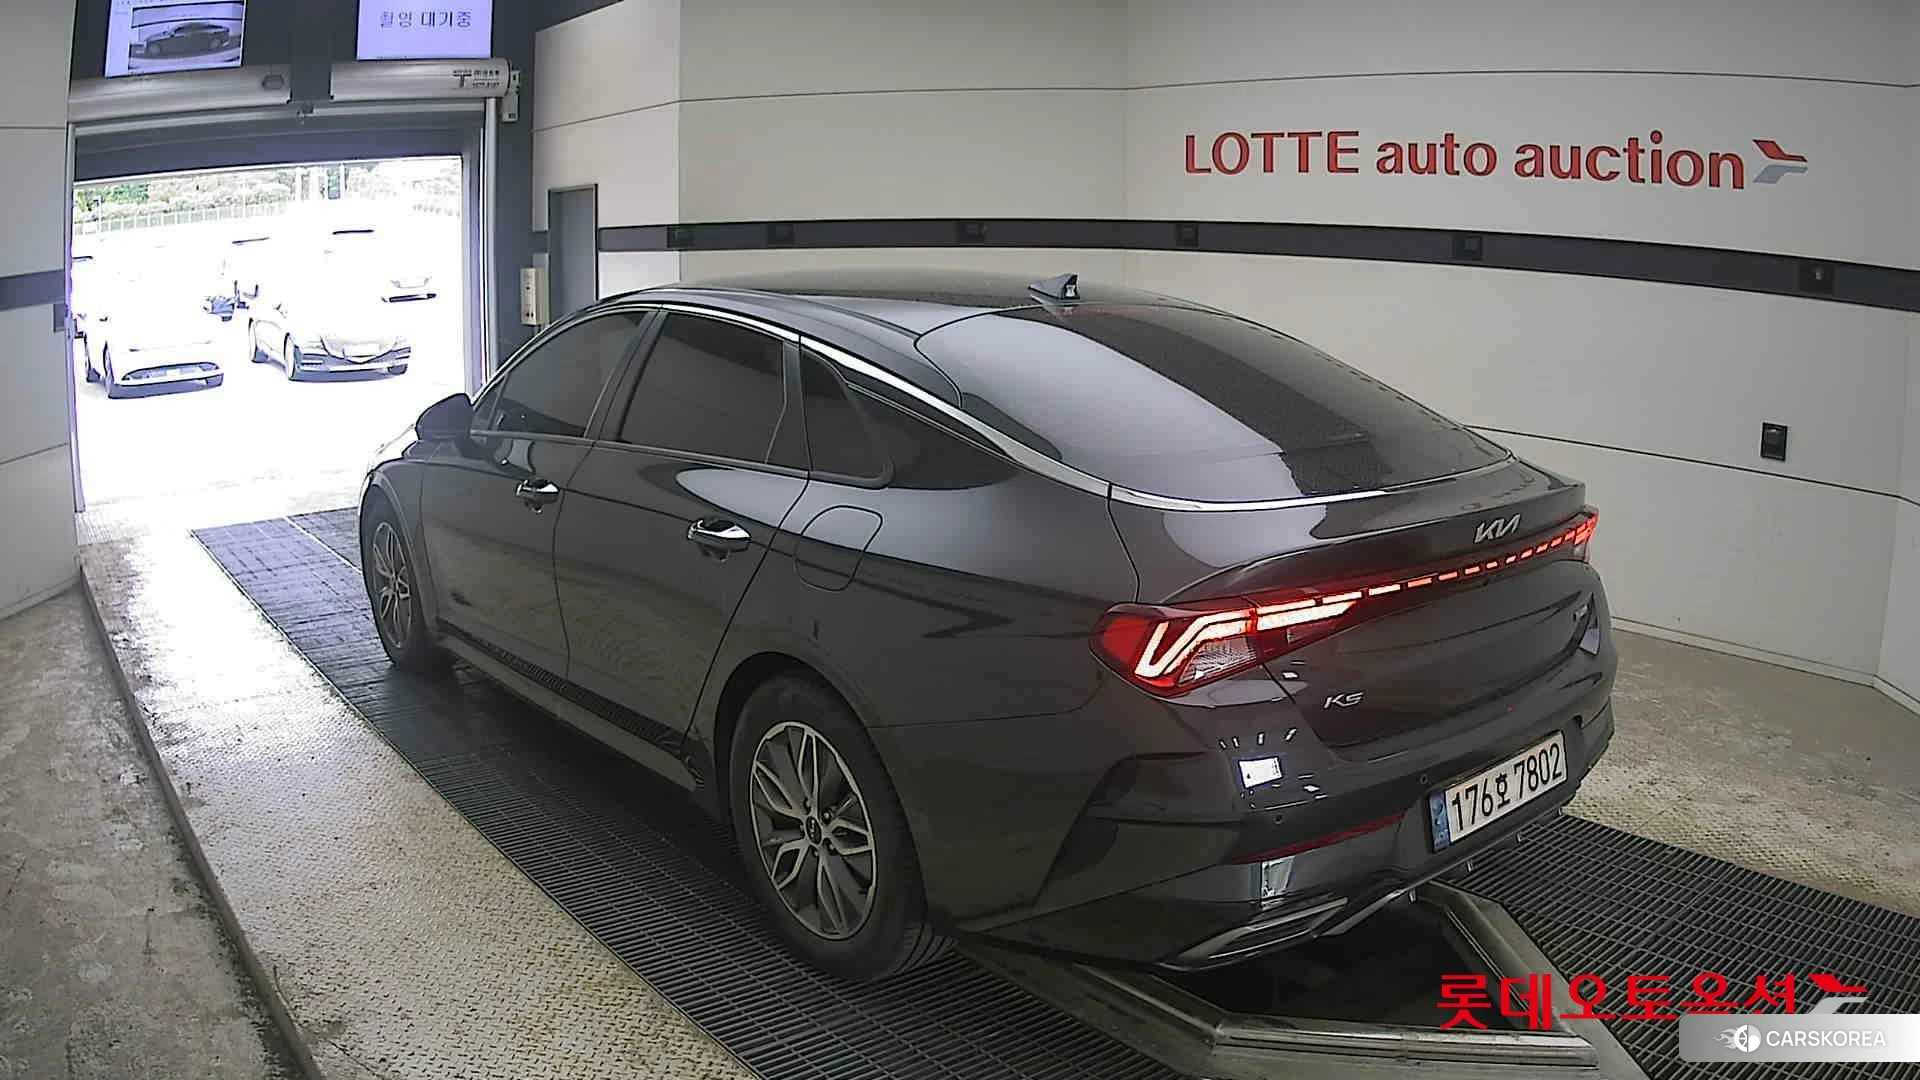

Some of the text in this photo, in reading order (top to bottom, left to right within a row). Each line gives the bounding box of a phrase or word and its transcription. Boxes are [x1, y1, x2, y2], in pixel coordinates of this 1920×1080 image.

[420, 10, 472, 28] 대기중
[1184, 129, 1745, 190] LOTTE auto auction
[1323, 692, 1364, 709] K5
[1513, 742, 1563, 801] 7802
